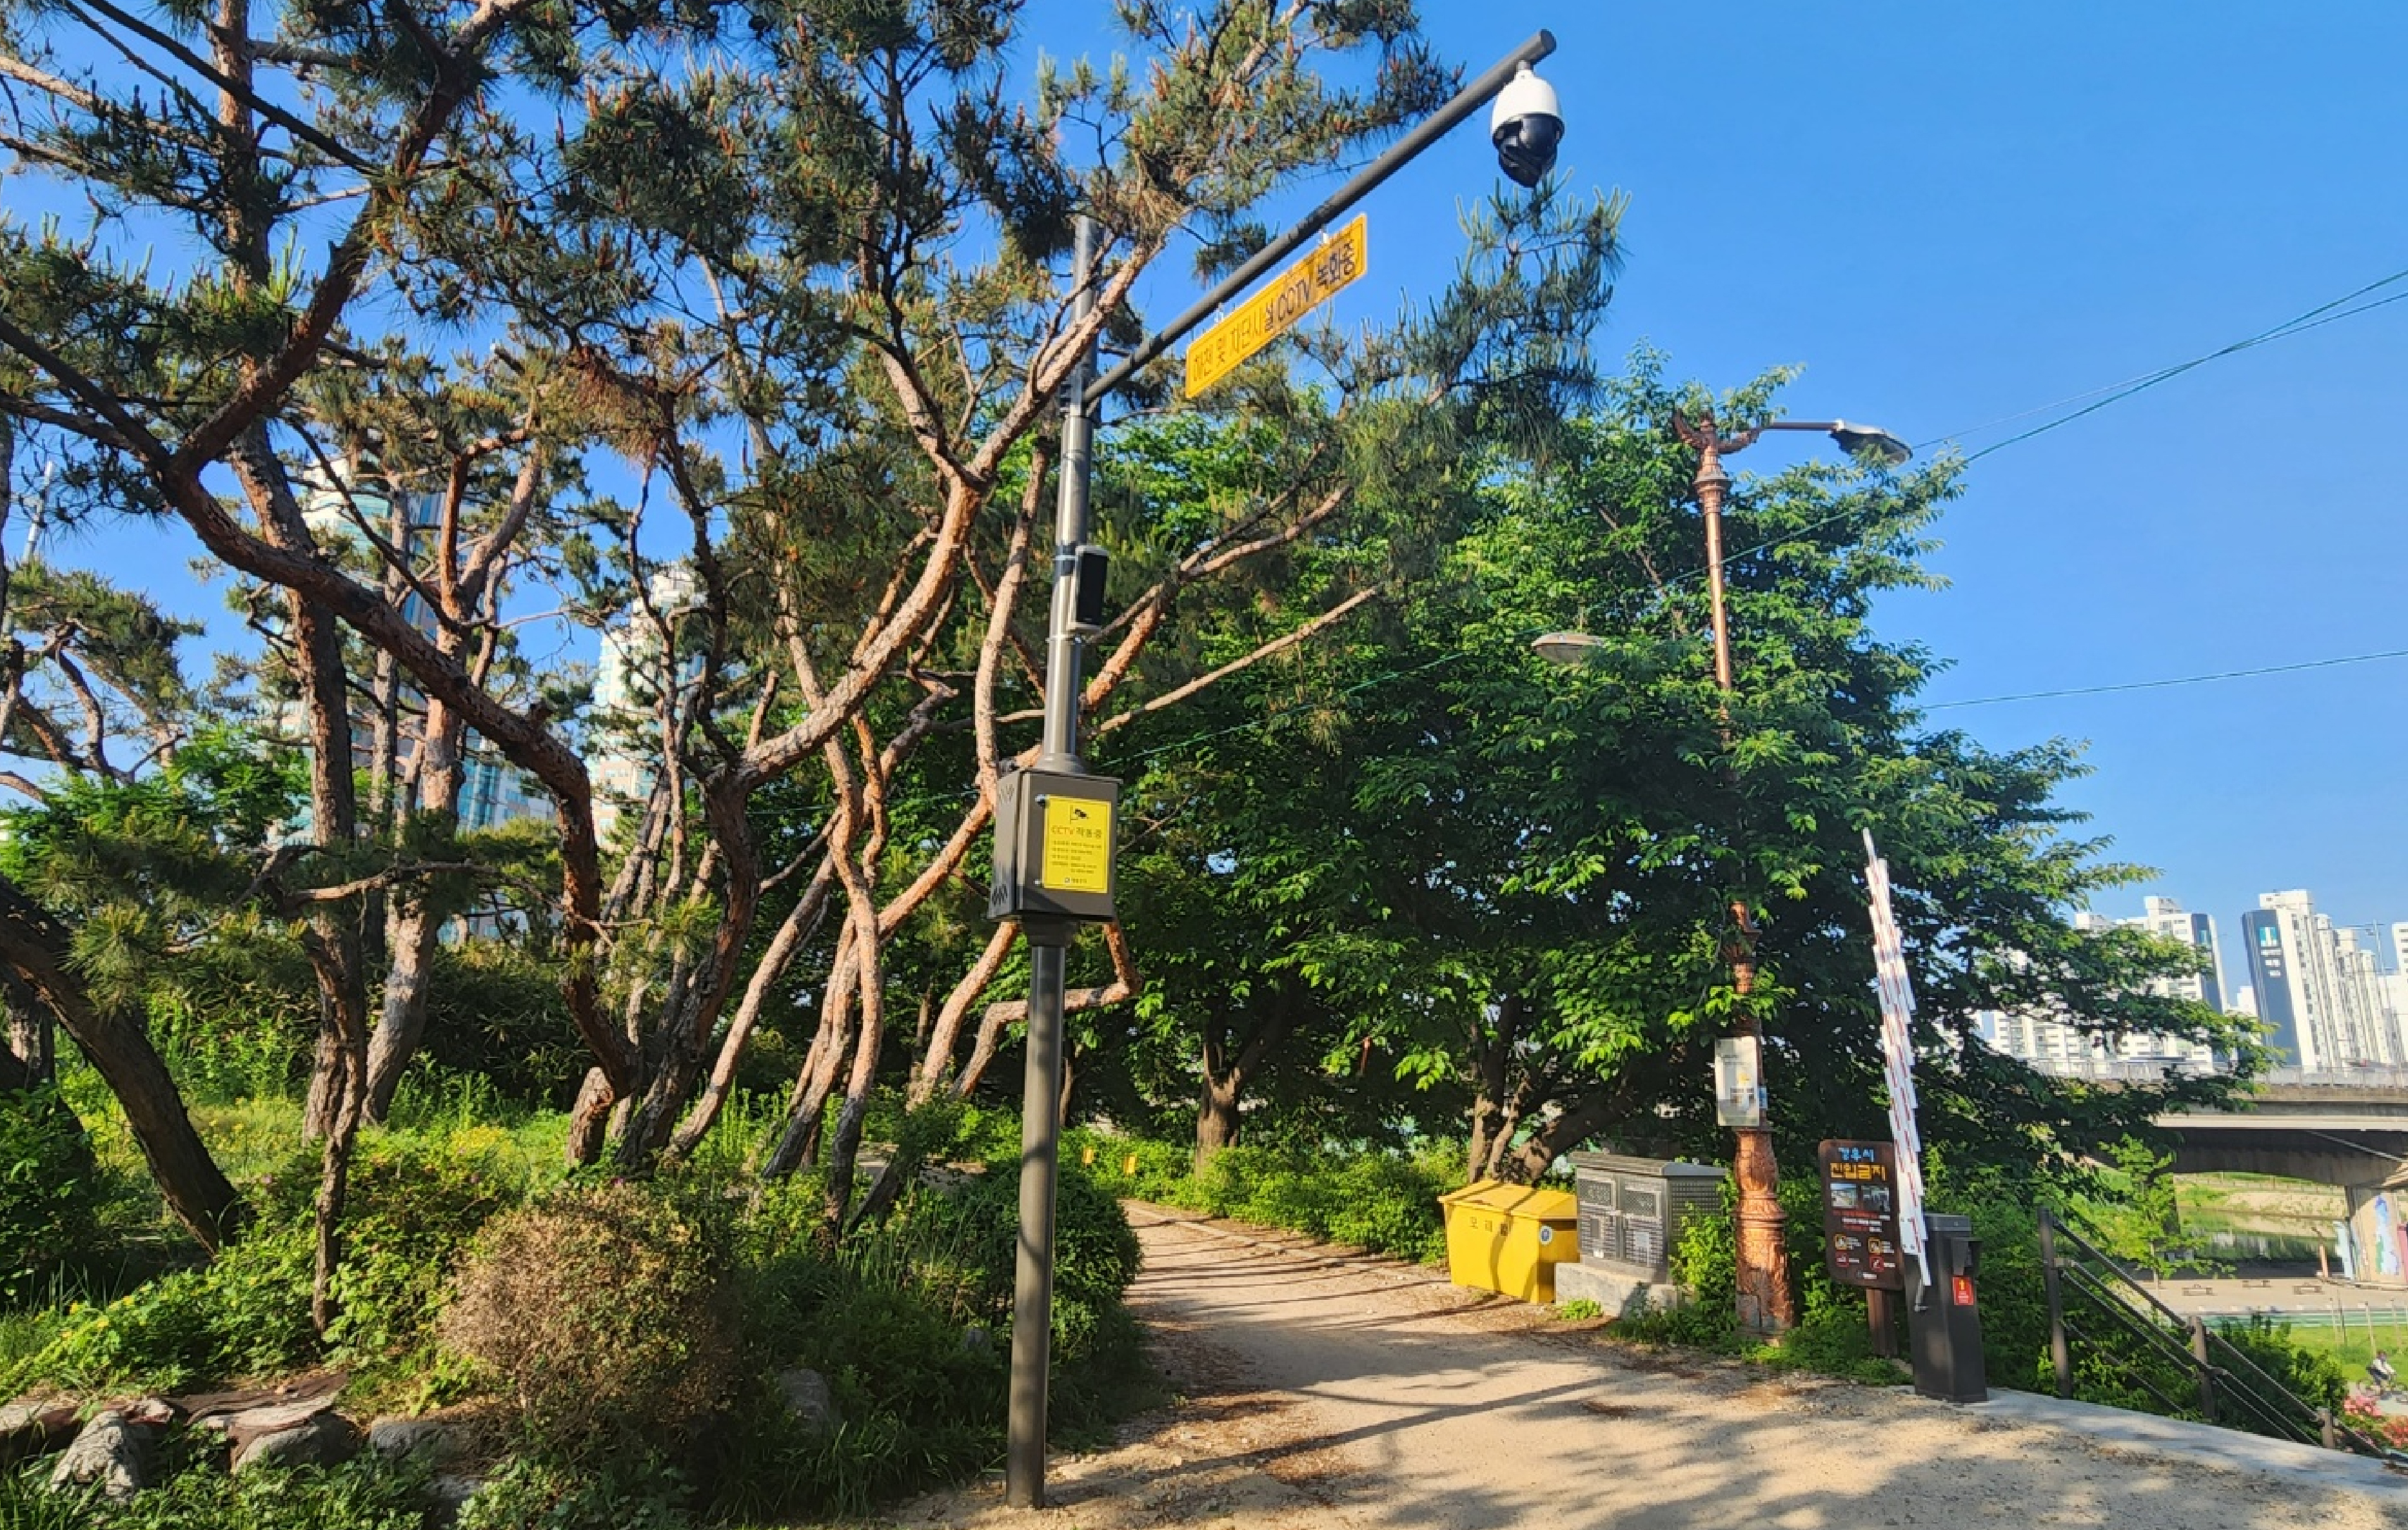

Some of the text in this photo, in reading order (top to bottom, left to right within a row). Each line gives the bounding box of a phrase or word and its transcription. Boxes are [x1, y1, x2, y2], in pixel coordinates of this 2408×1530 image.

[1278, 273, 1314, 322] CCTV
[1316, 239, 1356, 289] 녹화중
[1830, 1162, 1888, 1181] 진입금지
